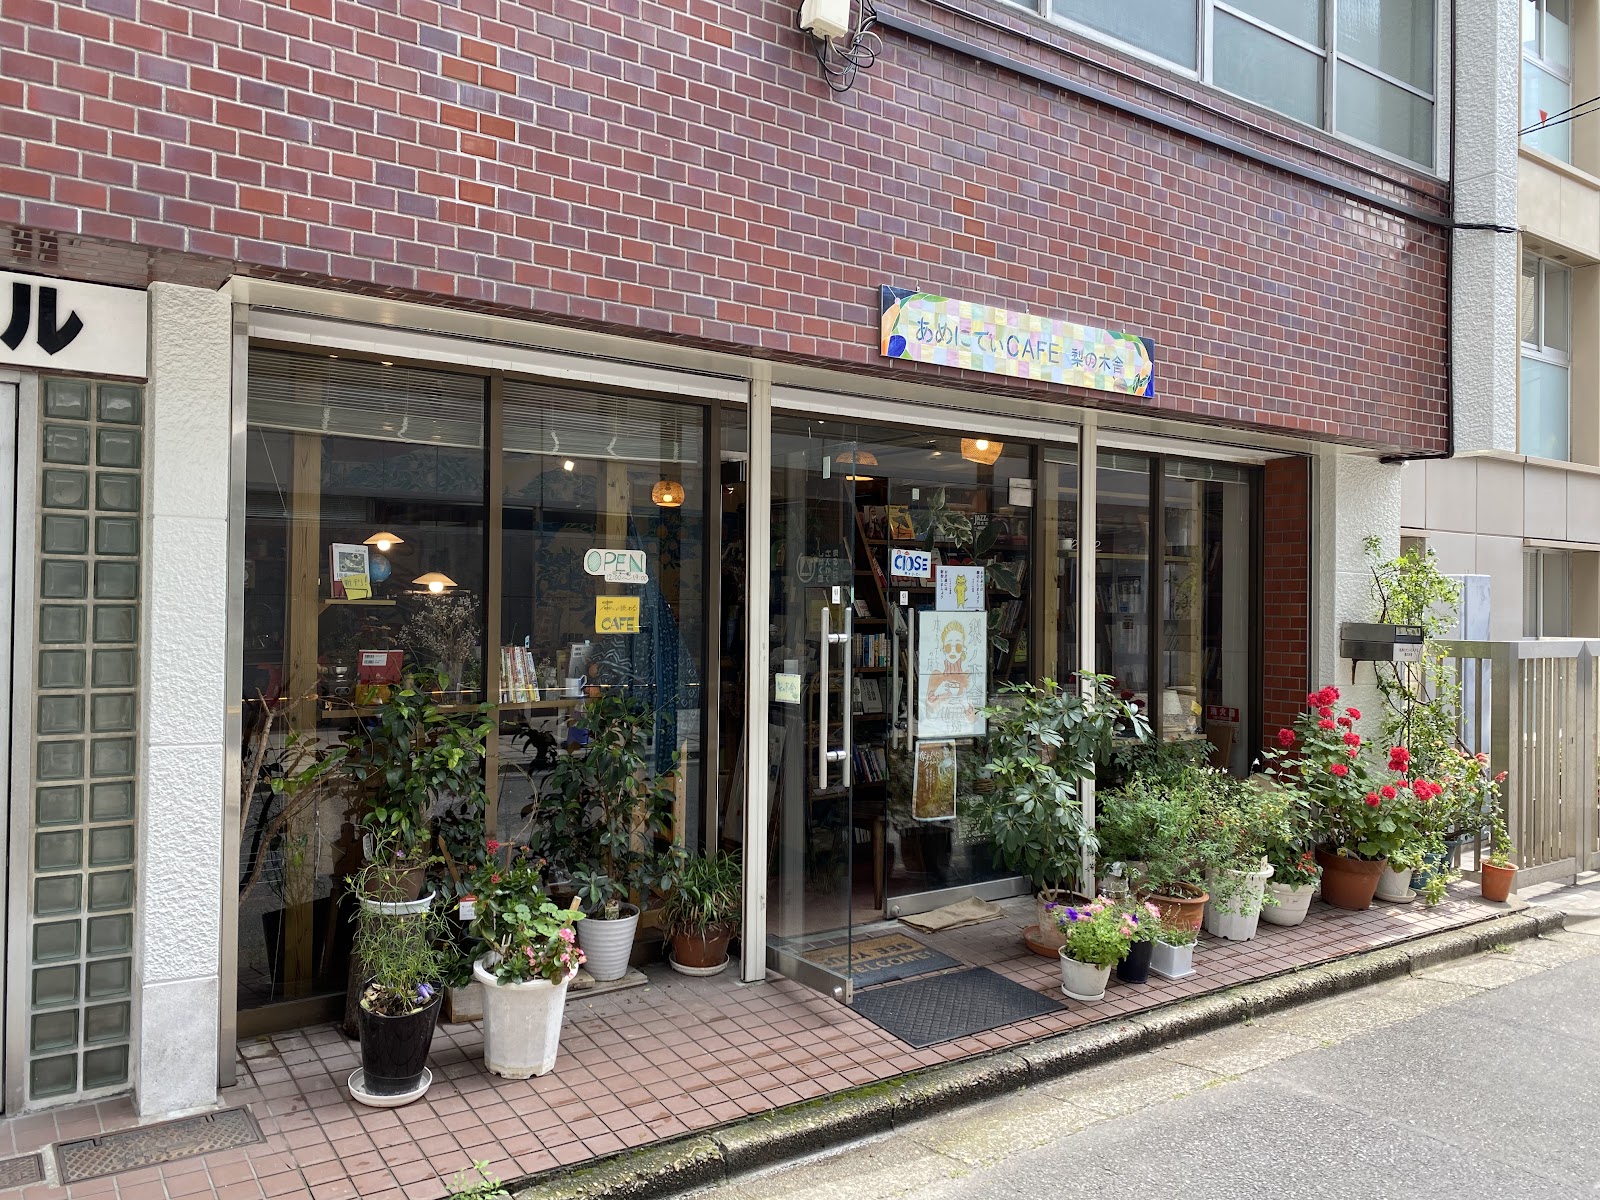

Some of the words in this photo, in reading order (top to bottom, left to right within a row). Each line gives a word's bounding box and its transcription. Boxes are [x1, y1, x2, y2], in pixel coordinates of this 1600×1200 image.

[0, 282, 84, 356] ル
[1071, 348, 1124, 374] 梨の木舎
[587, 550, 644, 573] OPEN
[601, 616, 635, 631] CAFE
